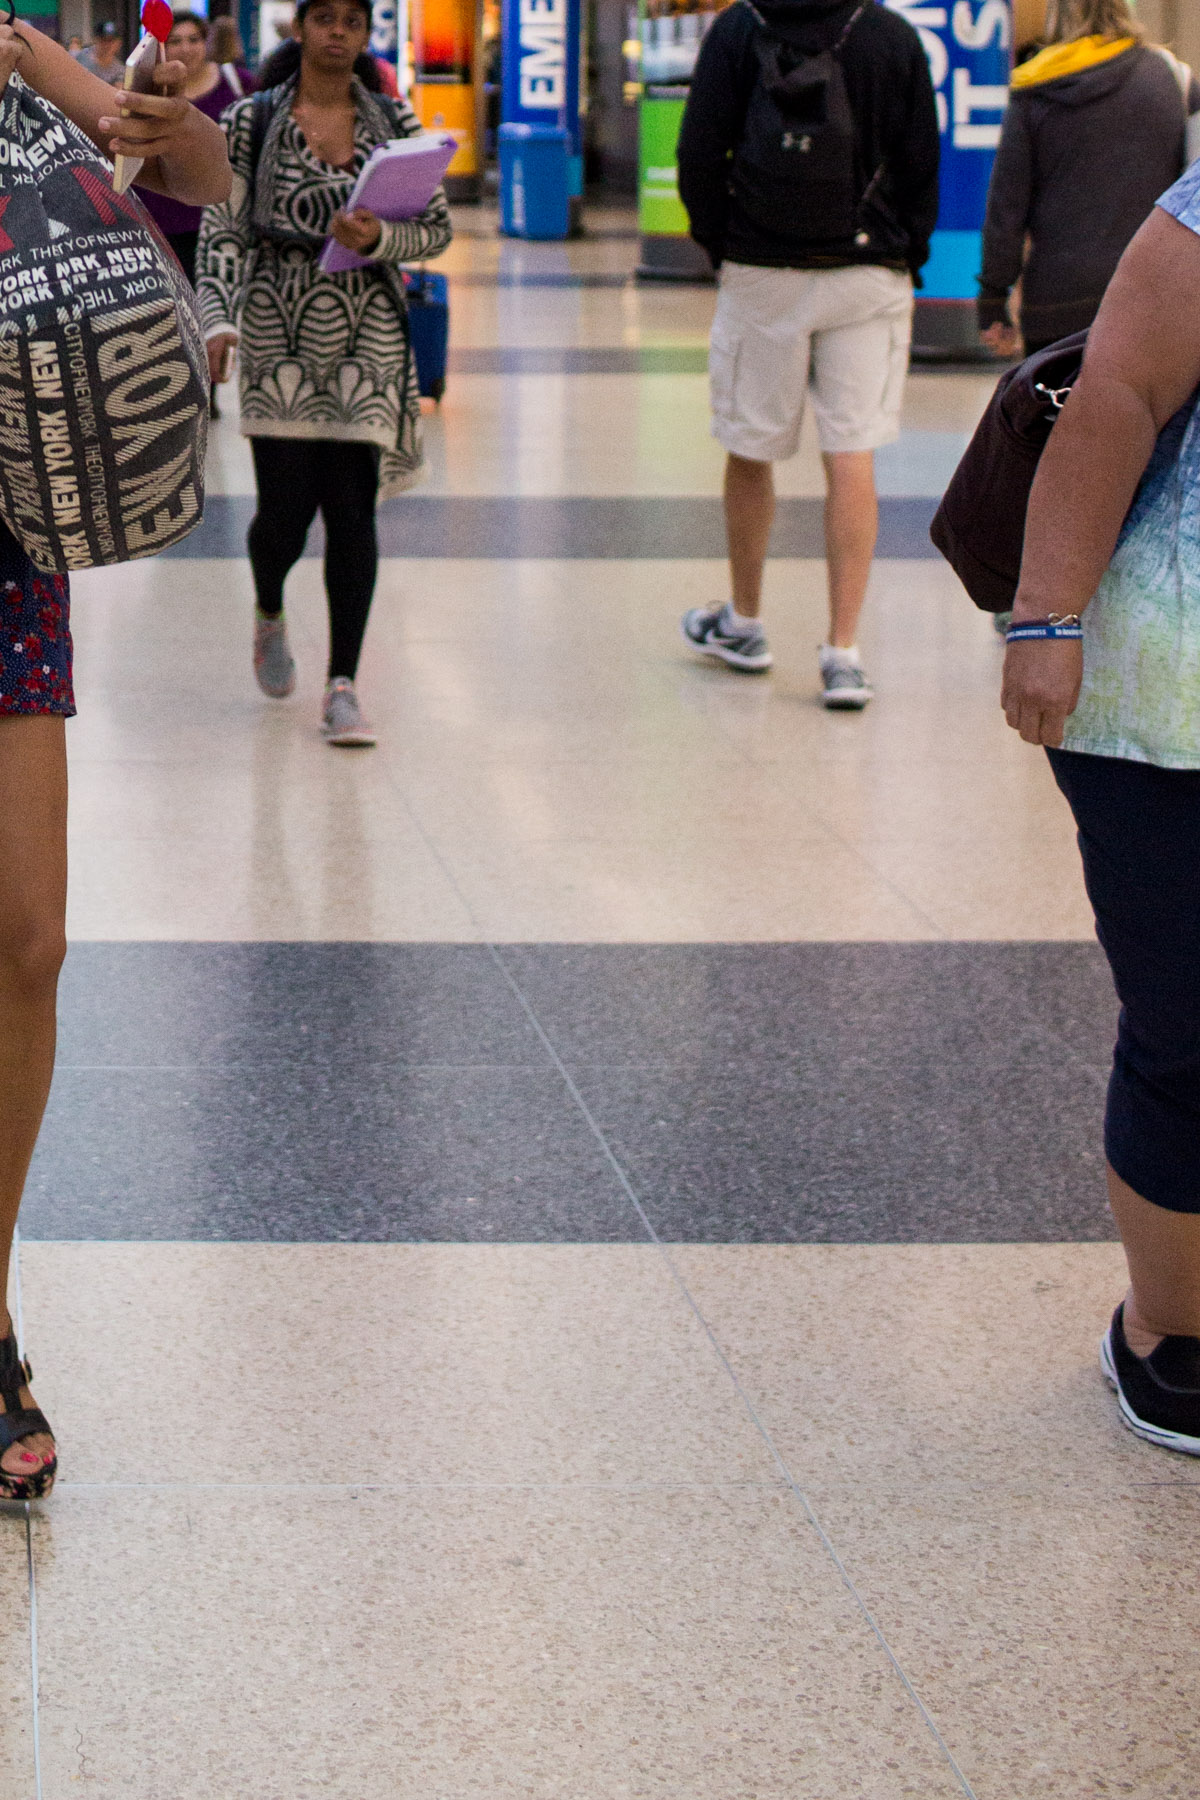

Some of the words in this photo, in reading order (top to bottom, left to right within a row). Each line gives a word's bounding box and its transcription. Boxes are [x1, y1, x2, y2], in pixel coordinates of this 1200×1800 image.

[951, 67, 1011, 150] IT
[106, 246, 153, 265] NEW
[27, 340, 65, 399] NEW
[36, 409, 75, 473] YORK
[47, 474, 82, 526] NEW
